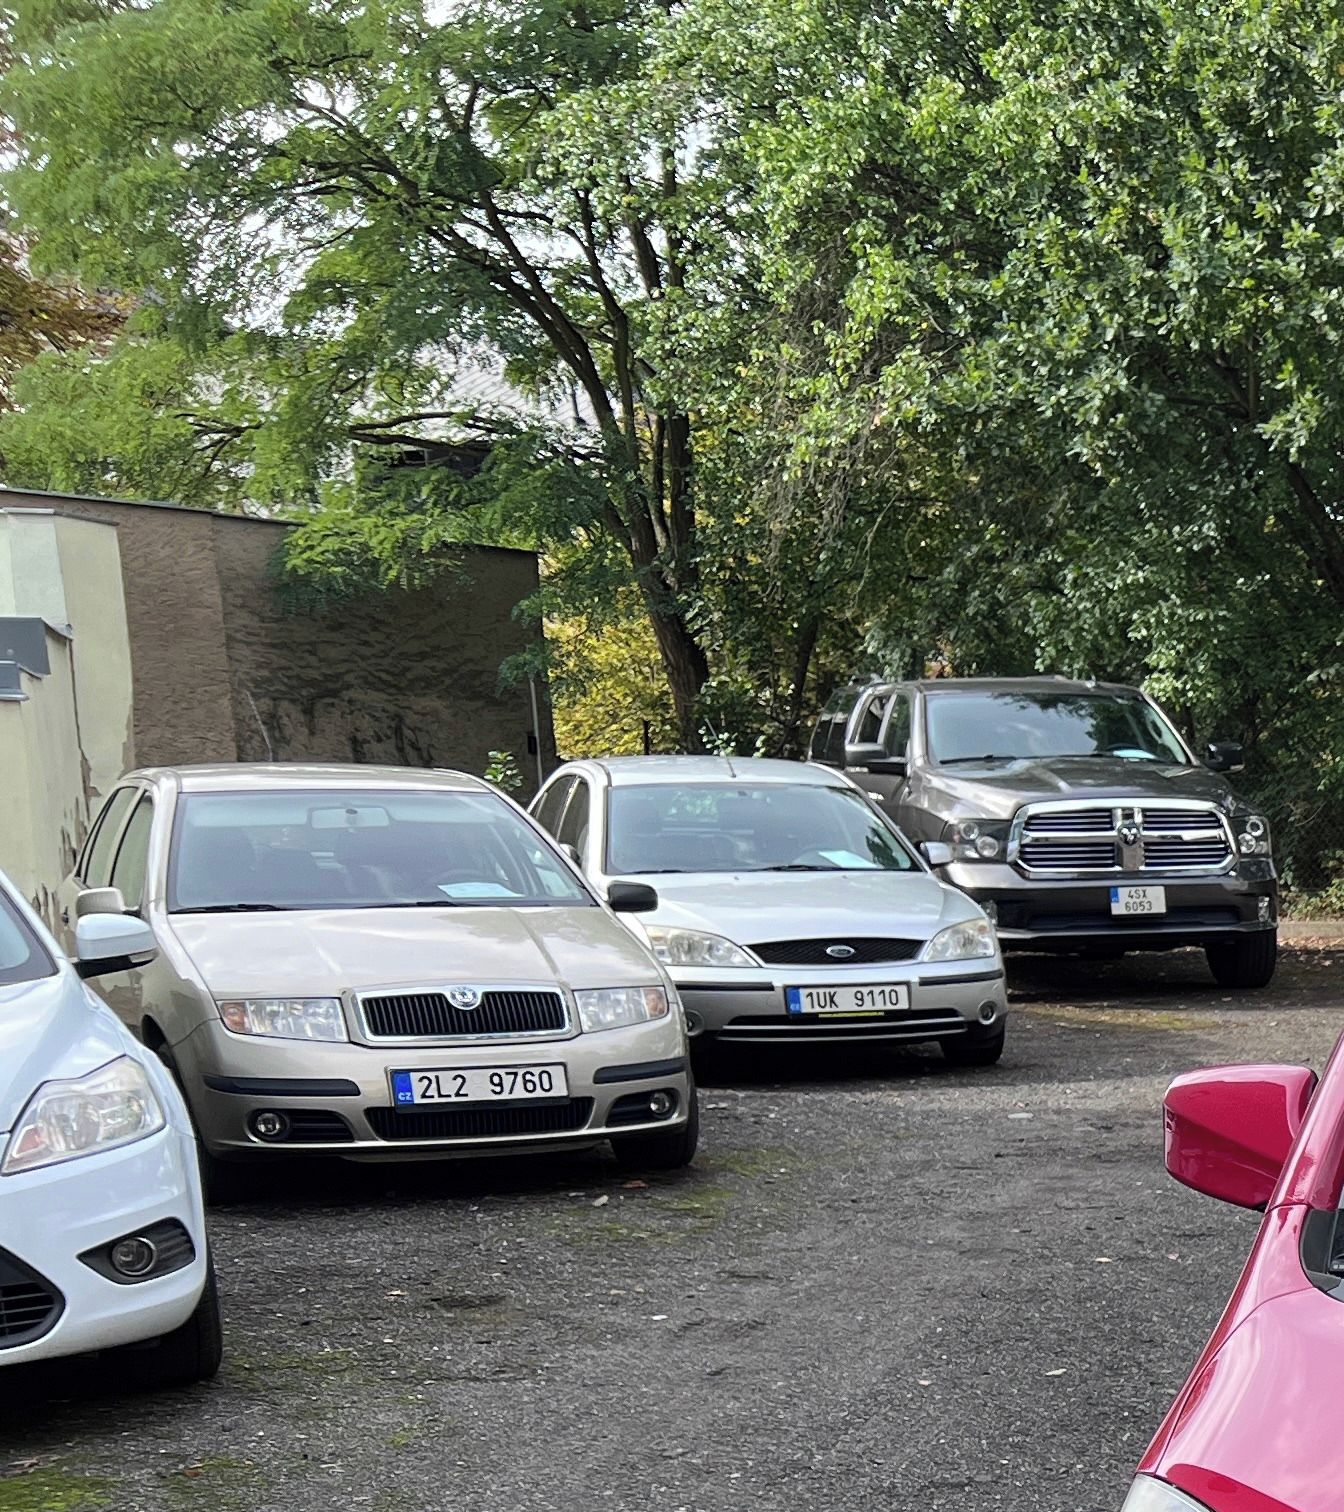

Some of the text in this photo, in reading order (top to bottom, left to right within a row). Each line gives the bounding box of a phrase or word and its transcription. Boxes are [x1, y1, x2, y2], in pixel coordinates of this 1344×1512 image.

[806, 989, 899, 1009] 1UK 9110
[397, 1070, 553, 1100] CZ 2L2 9760
